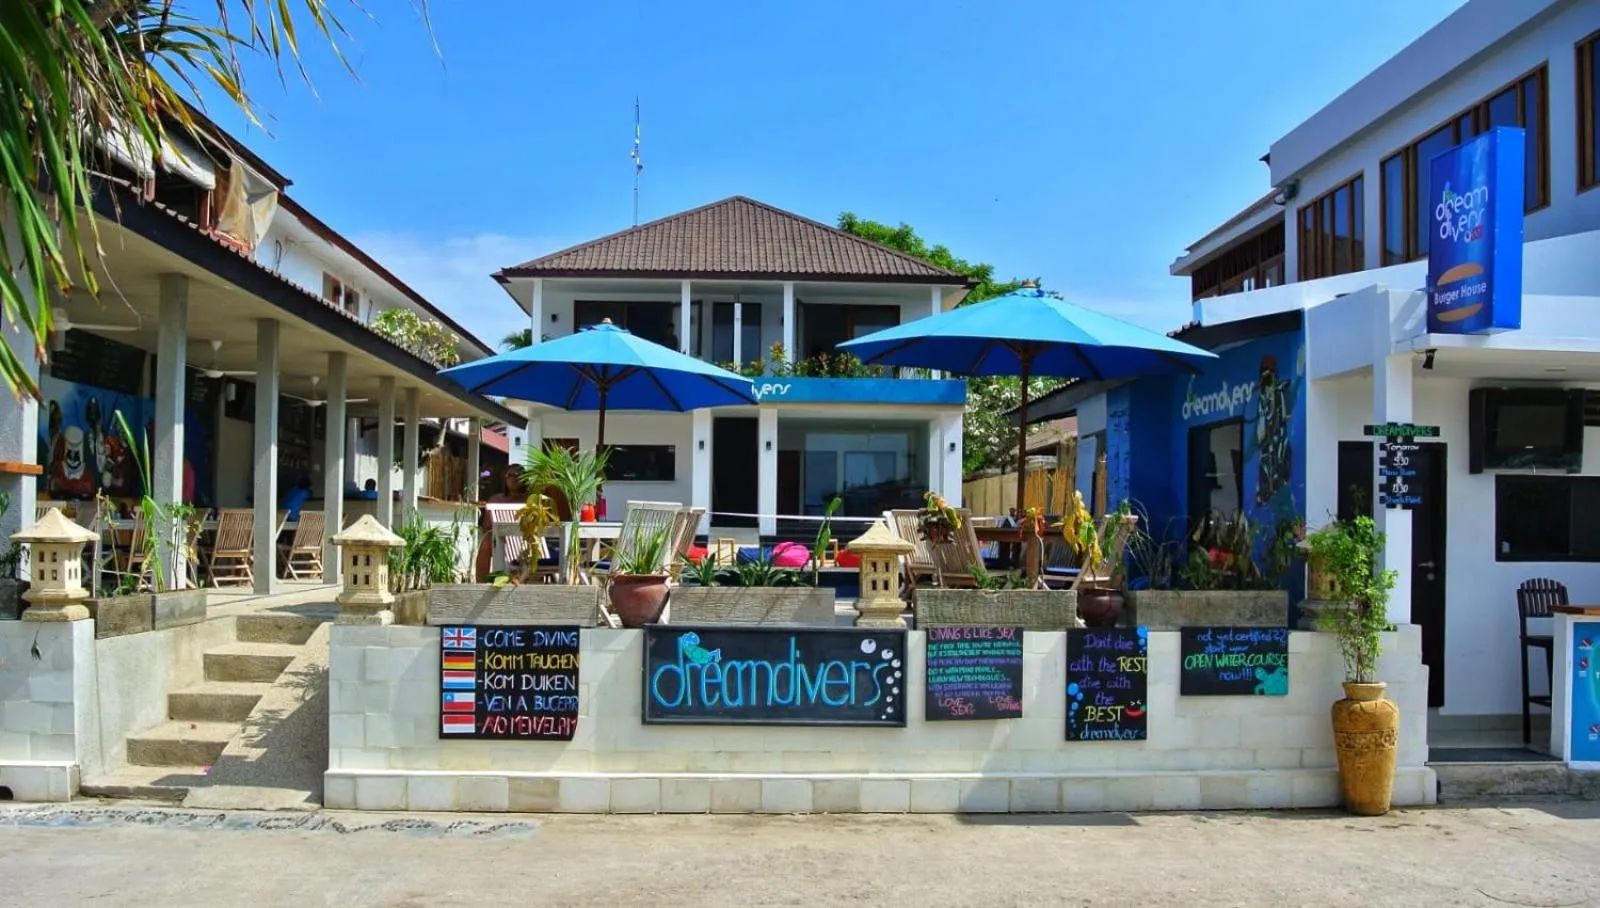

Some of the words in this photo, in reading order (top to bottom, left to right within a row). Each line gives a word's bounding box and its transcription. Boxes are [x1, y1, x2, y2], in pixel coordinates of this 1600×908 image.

[1434, 290, 1459, 305] Burger
[1460, 282, 1487, 297] House
[1182, 380, 1255, 420] dreamdivers
[1384, 442, 1419, 451] Tomorrow
[533, 631, 578, 648] DIVING
[973, 627, 994, 639] LIKE
[997, 626, 1016, 641] SEX
[1198, 627, 1214, 641] not
[1114, 635, 1134, 650] die
[526, 652, 579, 670] TAUCHEN
[1070, 655, 1093, 672] with
[1098, 655, 1116, 673] the
[1116, 655, 1148, 674] REST
[1184, 653, 1213, 670] OPEN
[1215, 652, 1247, 668] WATER
[1247, 652, 1288, 667] COURSE
[652, 636, 889, 707] dreamdivers
[521, 674, 576, 691] DUIKEN
[1078, 675, 1102, 689] dive
[1107, 675, 1131, 689] with
[516, 695, 528, 711] A
[1095, 691, 1114, 705] the
[1084, 705, 1124, 722] BEST
